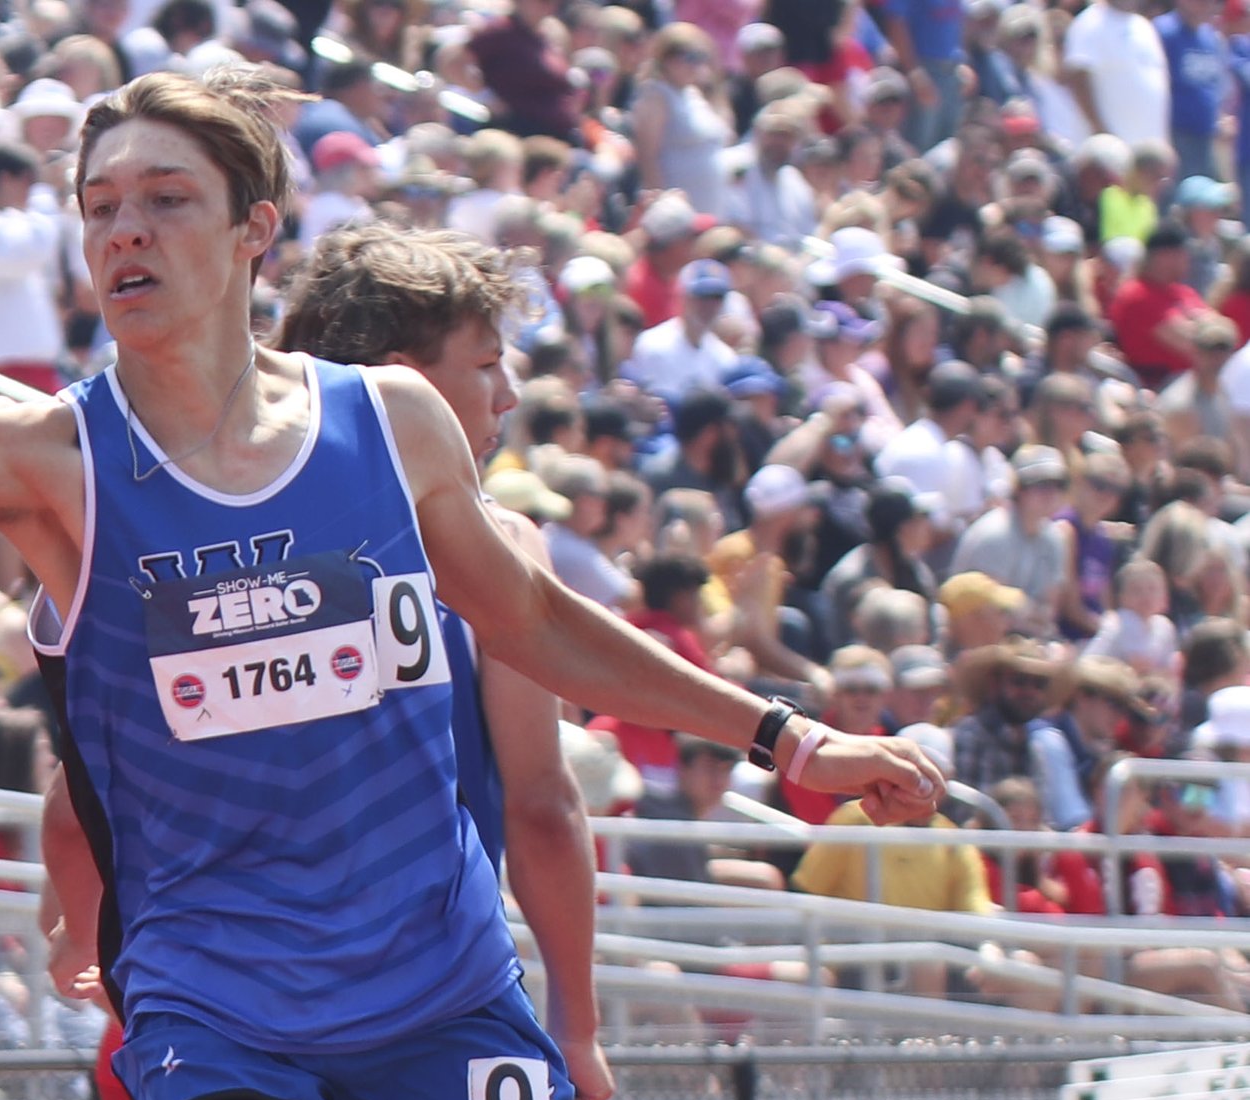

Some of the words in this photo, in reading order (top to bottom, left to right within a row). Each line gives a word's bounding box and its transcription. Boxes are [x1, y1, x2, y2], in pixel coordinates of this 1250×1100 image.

[187, 579, 322, 635] ZERO
[216, 571, 288, 595] SHOW-ME
[389, 580, 432, 682] 9
[221, 652, 317, 700] 1764
